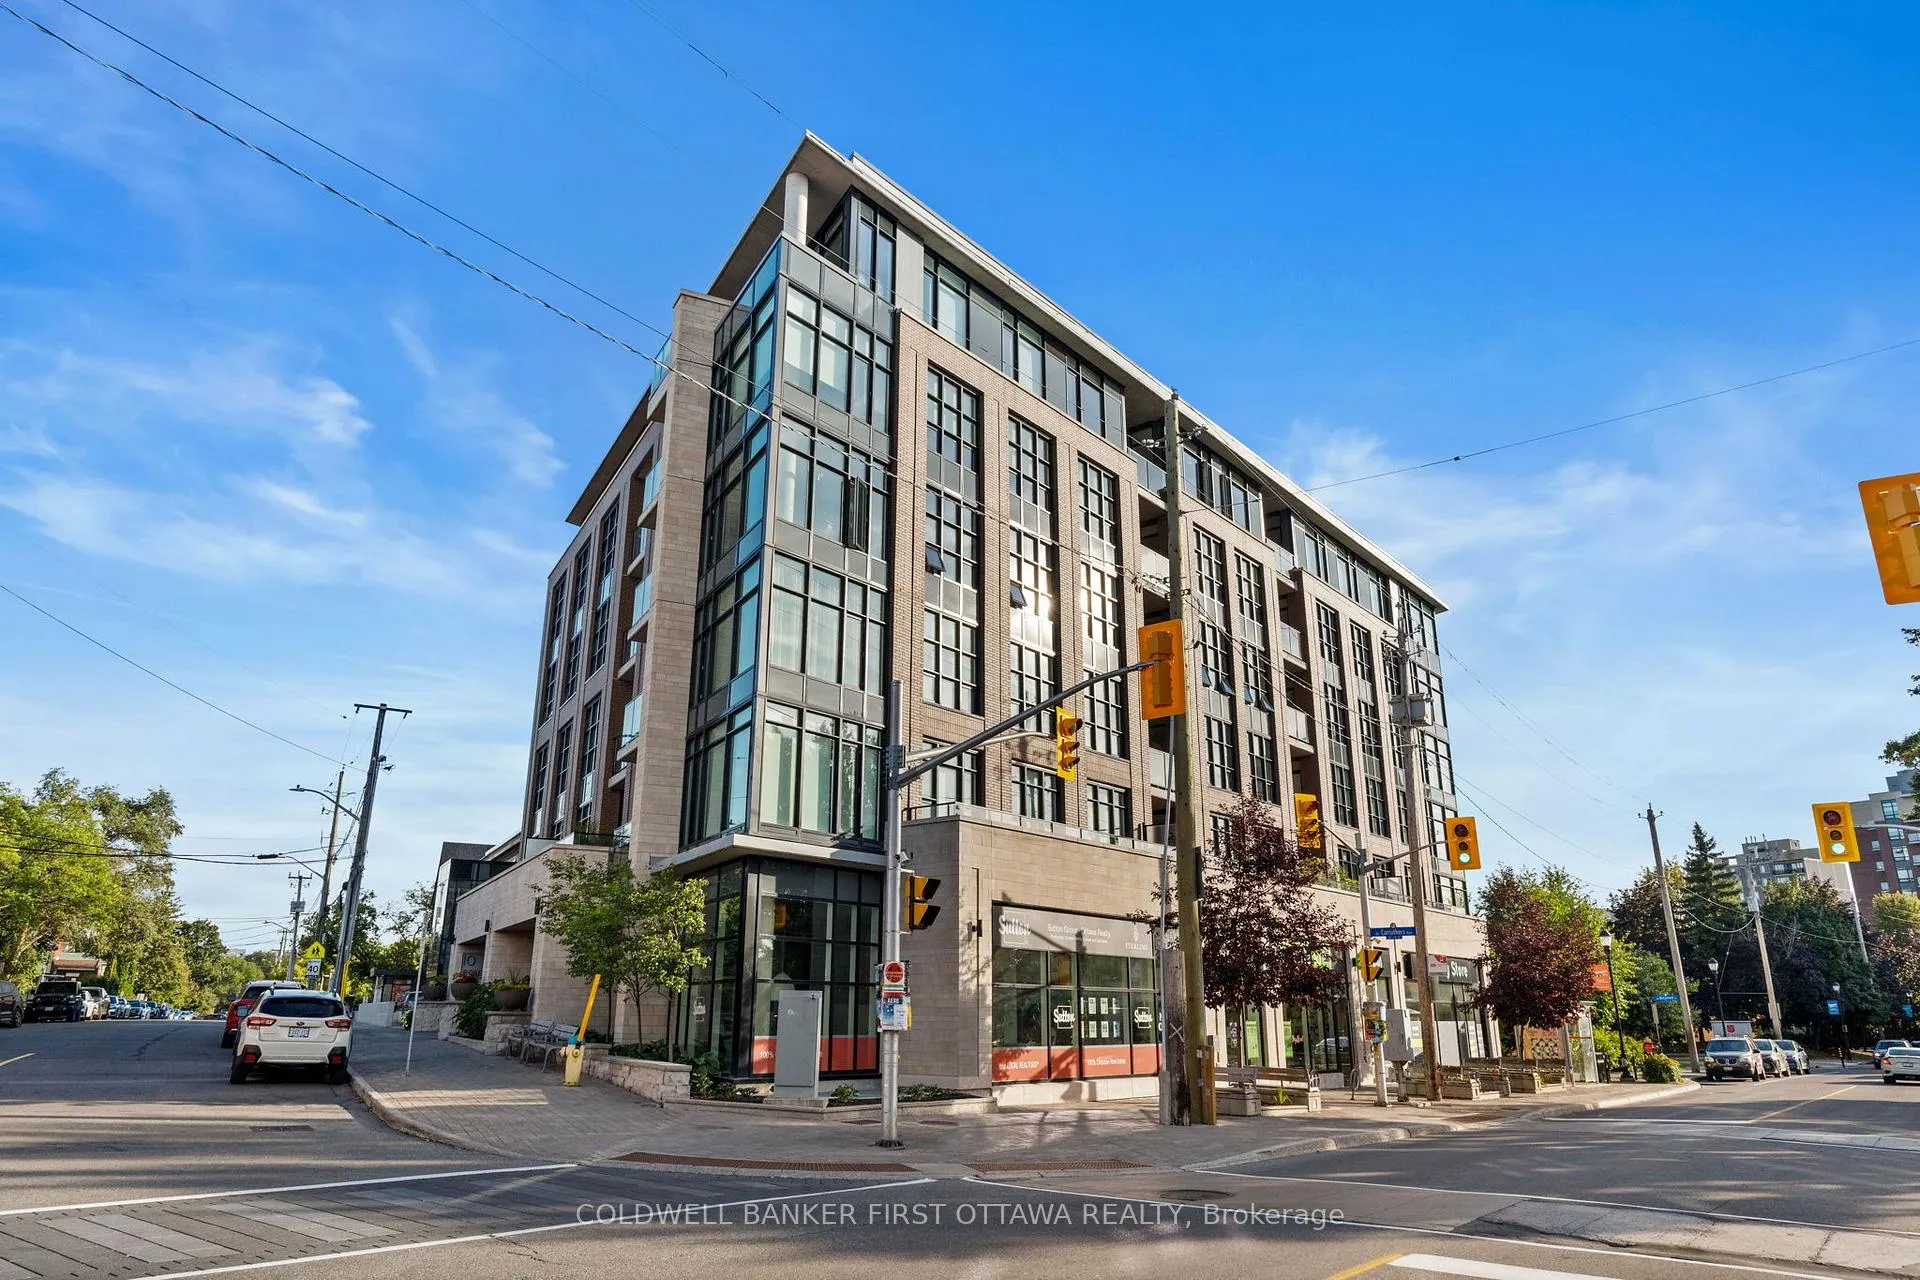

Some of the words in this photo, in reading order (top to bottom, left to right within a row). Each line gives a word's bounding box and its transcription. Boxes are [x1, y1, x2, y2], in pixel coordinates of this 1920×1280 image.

[999, 914, 1031, 935] Sutton
[308, 965, 318, 973] 40
[1450, 960, 1468, 978] Store
[1053, 1008, 1076, 1024] Sutton
[1134, 1009, 1154, 1024] Sutton
